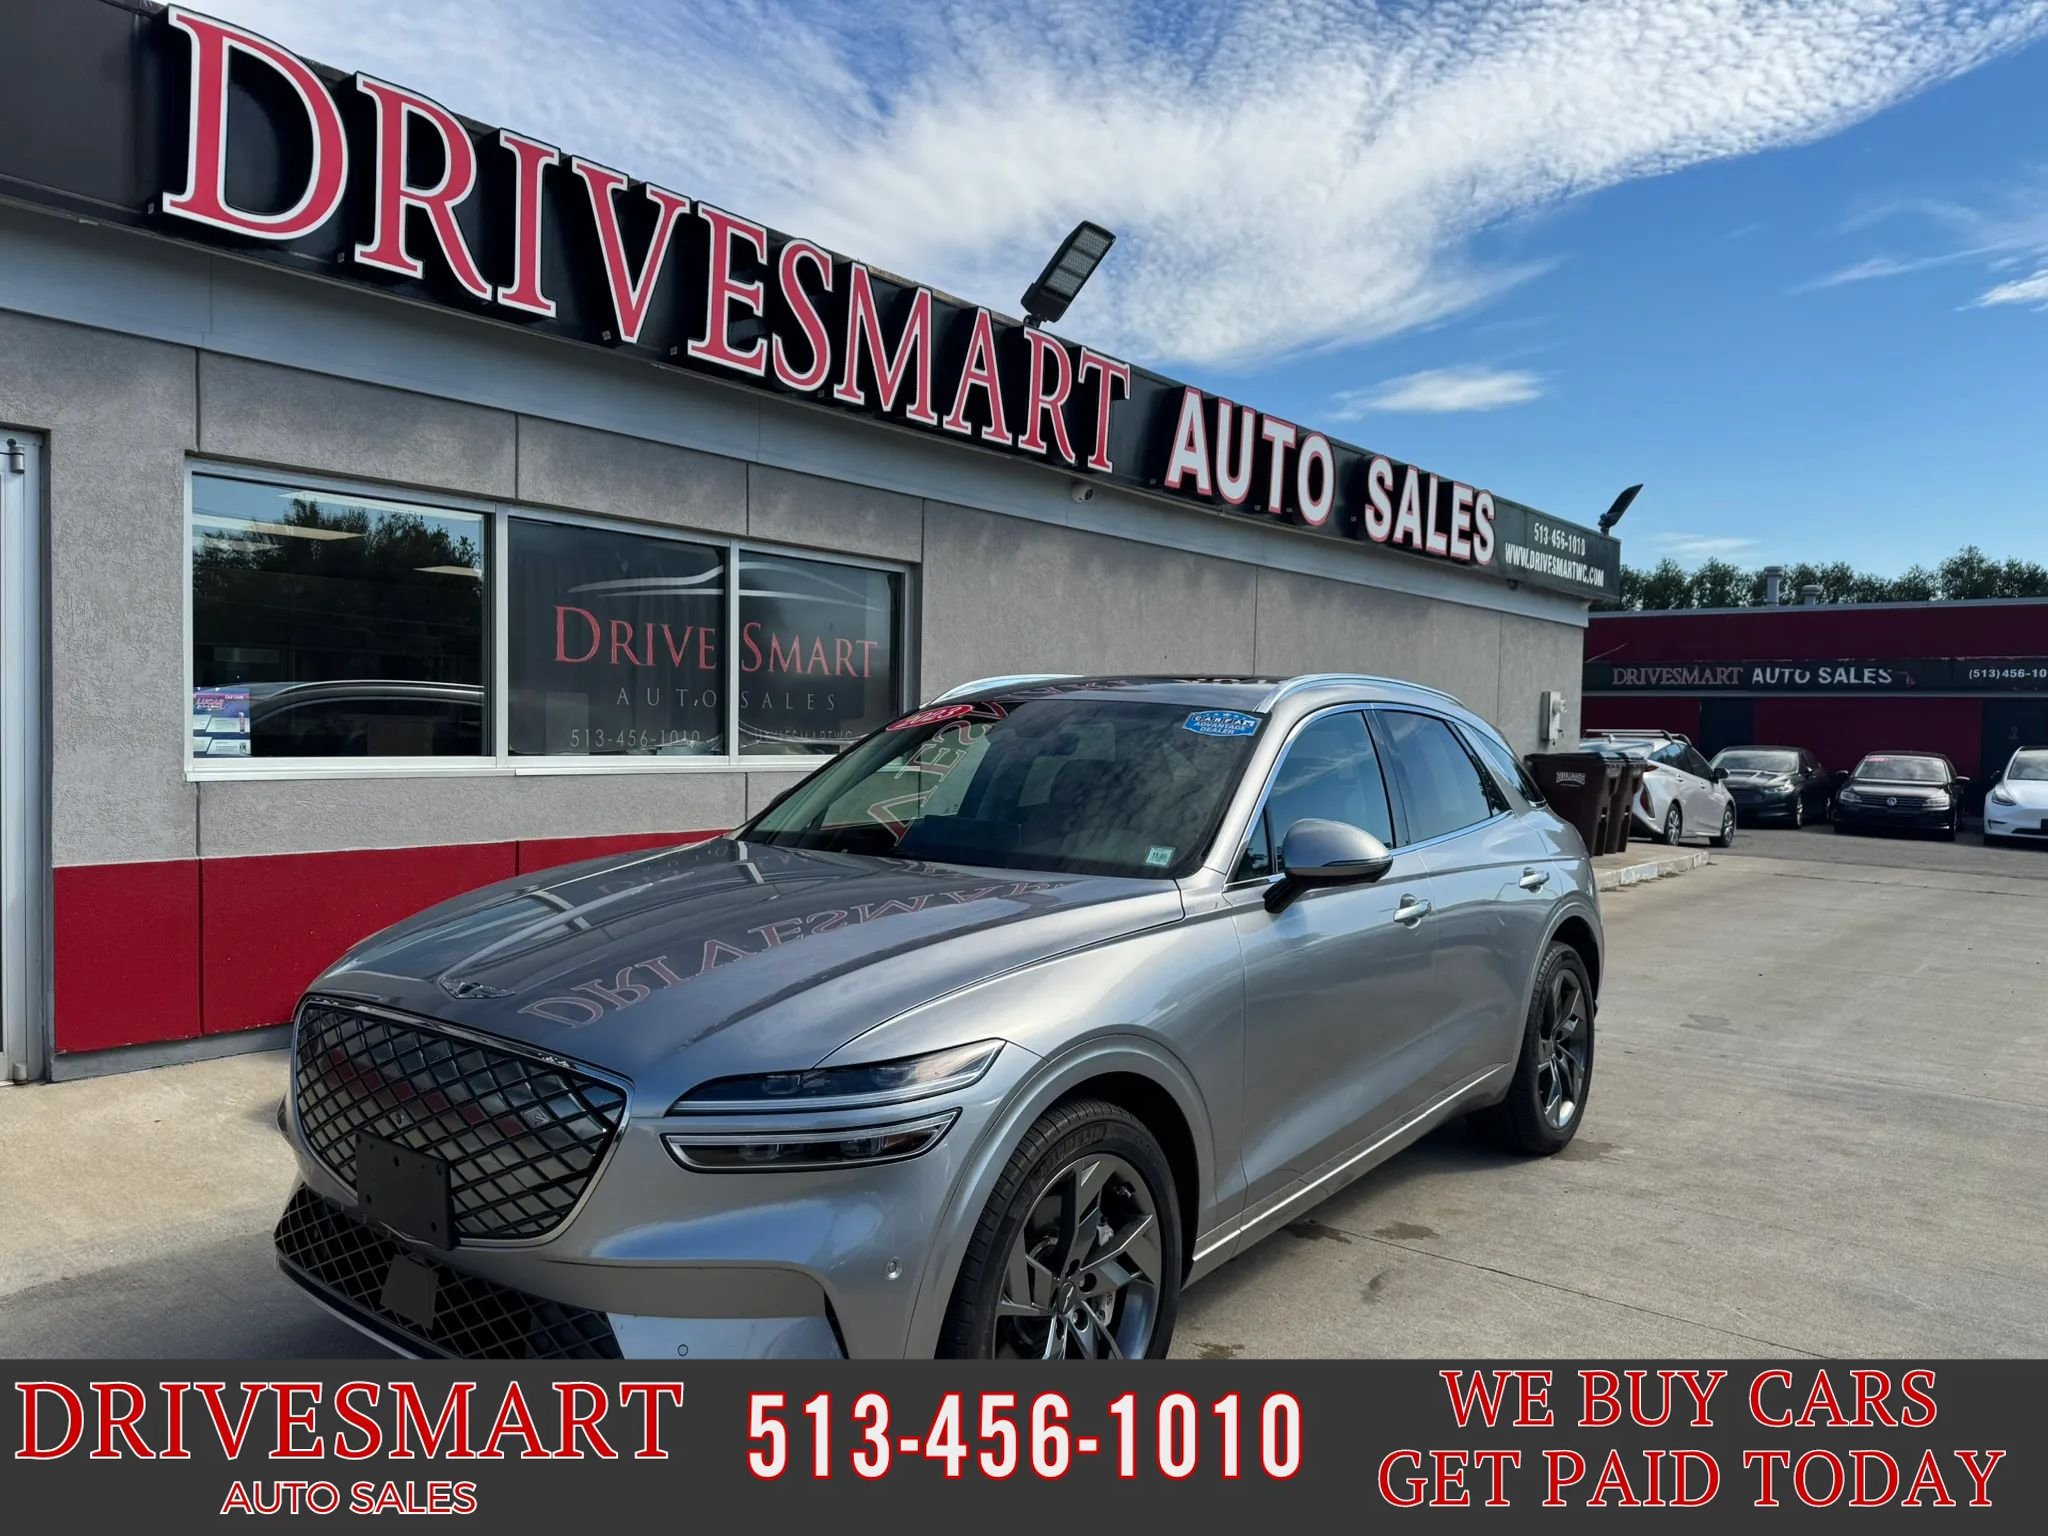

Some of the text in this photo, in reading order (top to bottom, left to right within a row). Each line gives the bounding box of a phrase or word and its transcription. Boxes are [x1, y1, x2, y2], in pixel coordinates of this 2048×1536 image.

[163, 5, 1496, 566] DRIVESMART AUTO SALES
[1504, 541, 1605, 588] WWW.DRIVESMARTWC.COM
[554, 605, 879, 679] DRIVE SMART
[1612, 666, 1894, 686] DRIVESMART AUTO SALES
[616, 687, 836, 711] AUTO SALES
[1193, 721, 1247, 731] ADVANTAGE
[1200, 727, 1235, 735] DEALER
